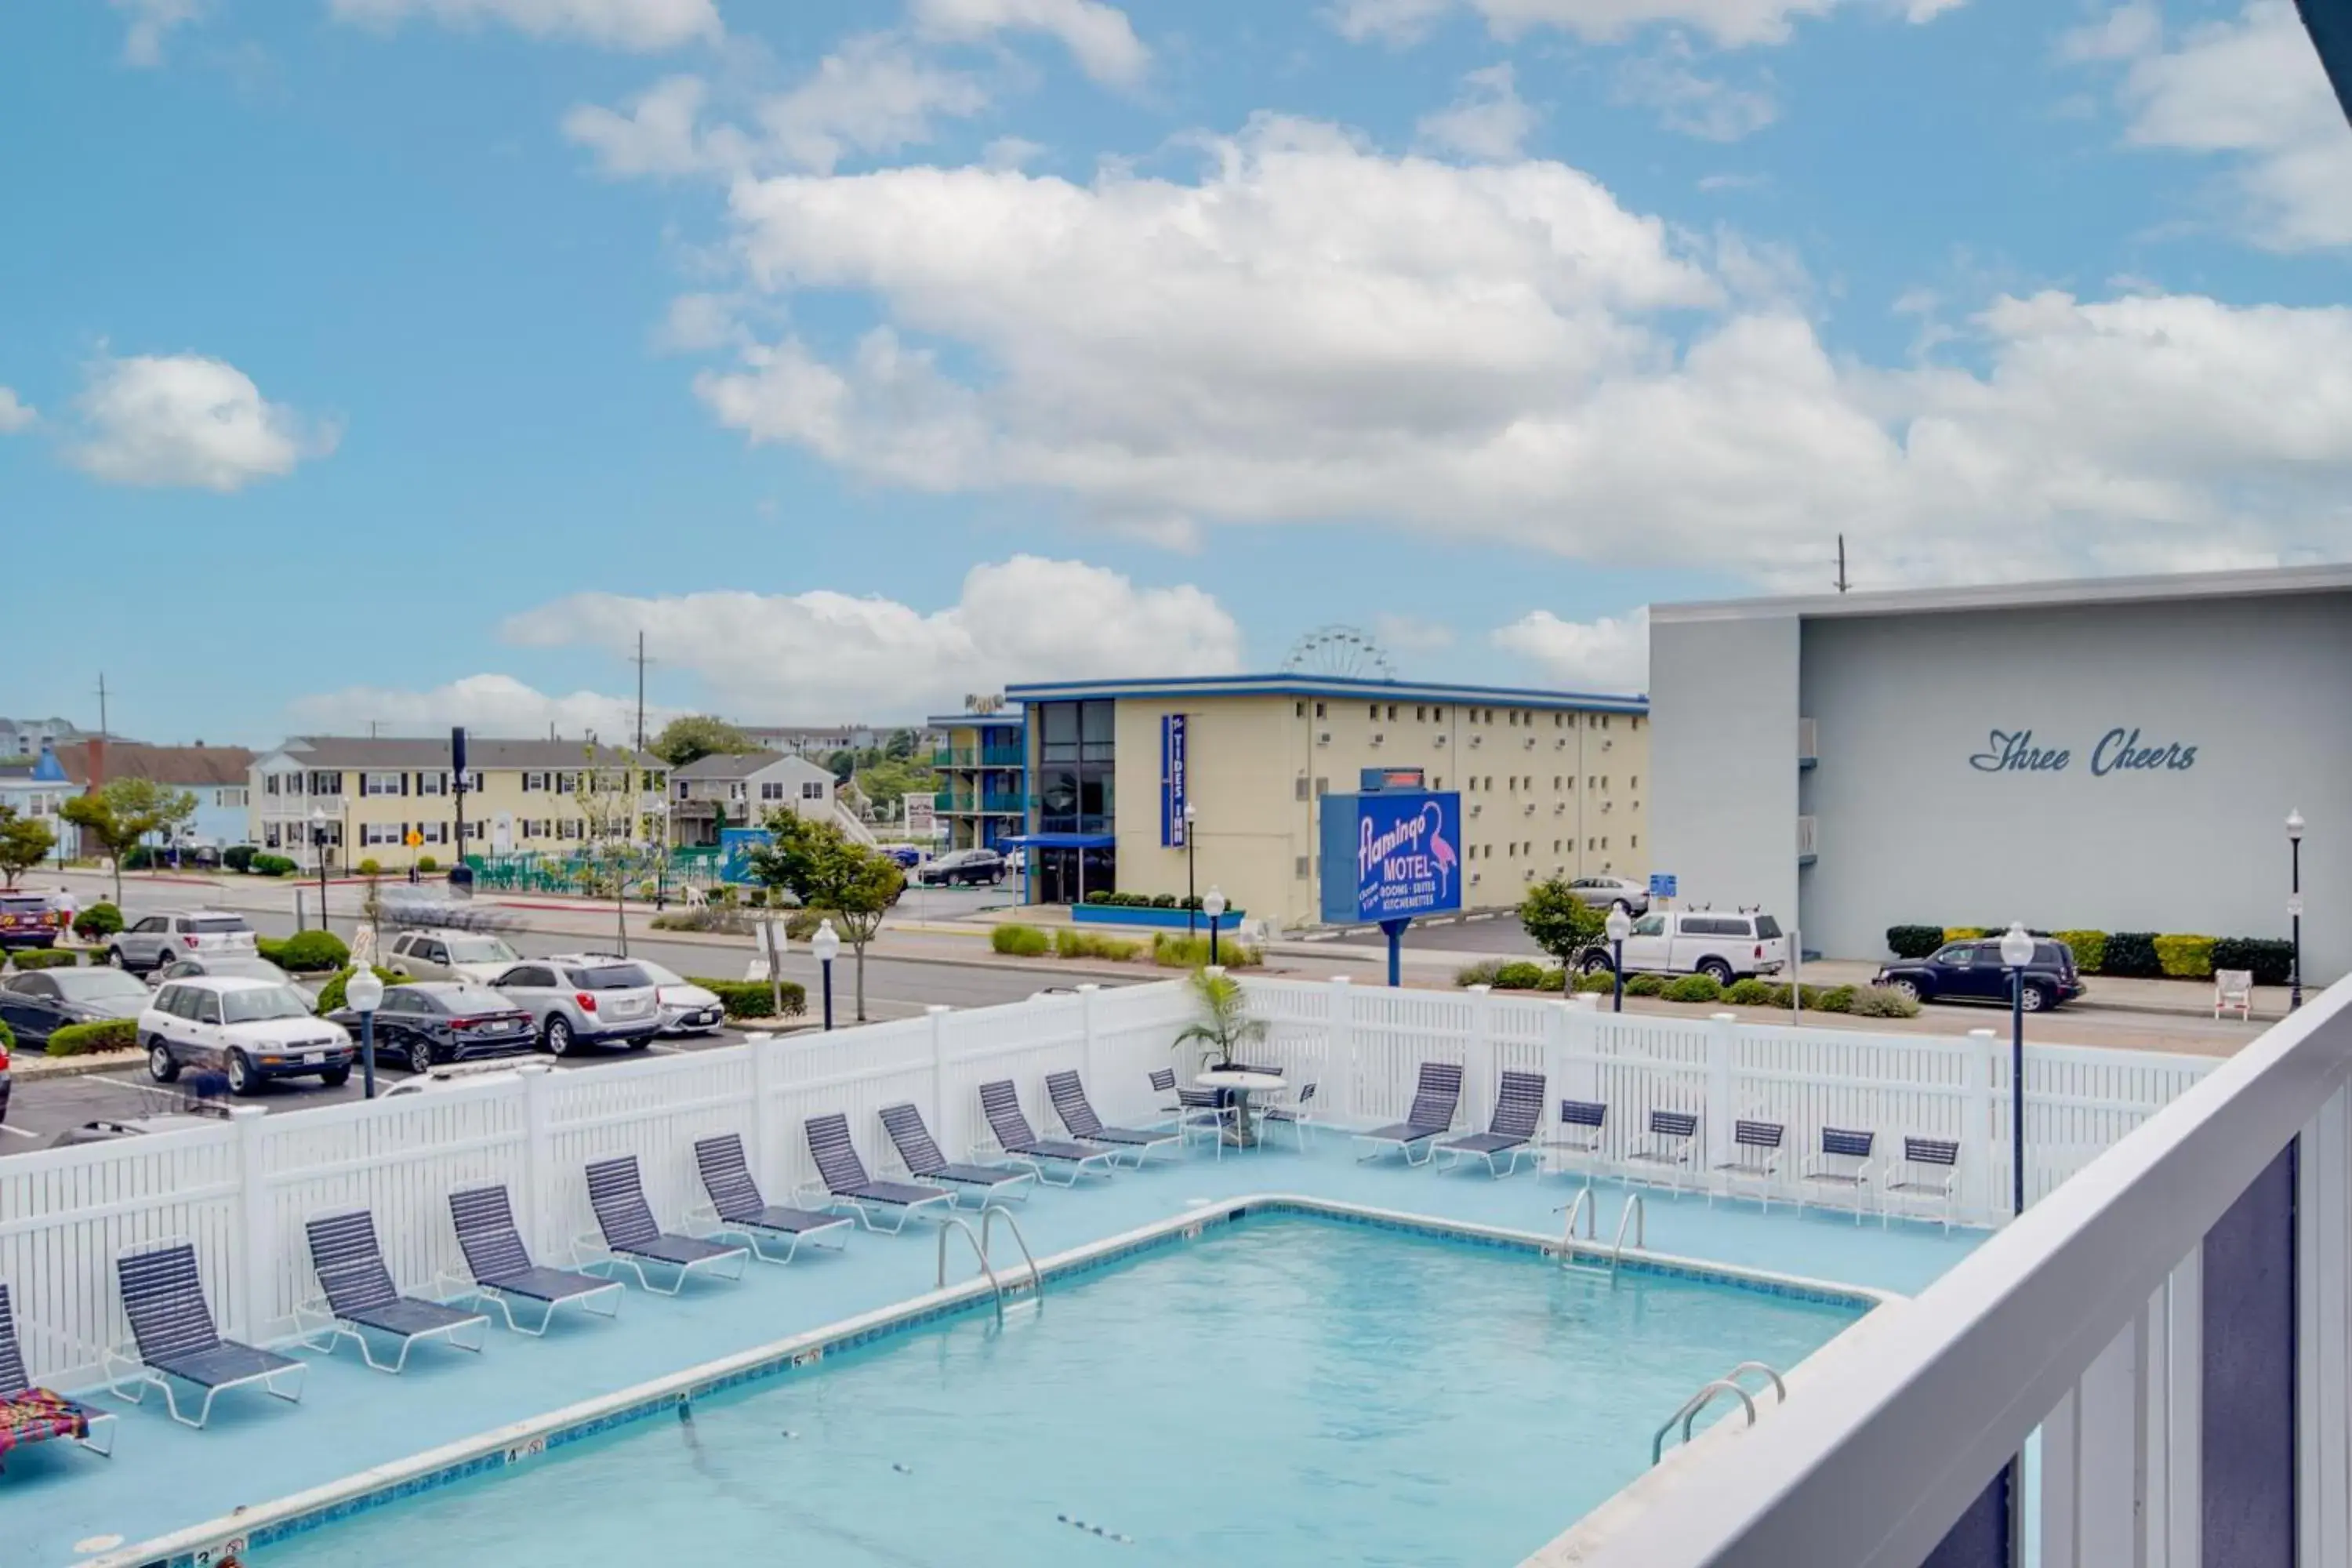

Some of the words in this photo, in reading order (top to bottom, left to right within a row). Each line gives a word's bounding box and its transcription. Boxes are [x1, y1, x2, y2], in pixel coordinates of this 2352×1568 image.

[1174, 733, 1183, 798] TIDES
[1969, 728, 2071, 772] Three
[2090, 728, 2198, 777] Cheers
[1174, 804, 1184, 843] INN
[1383, 855, 1433, 882] MOTEL
